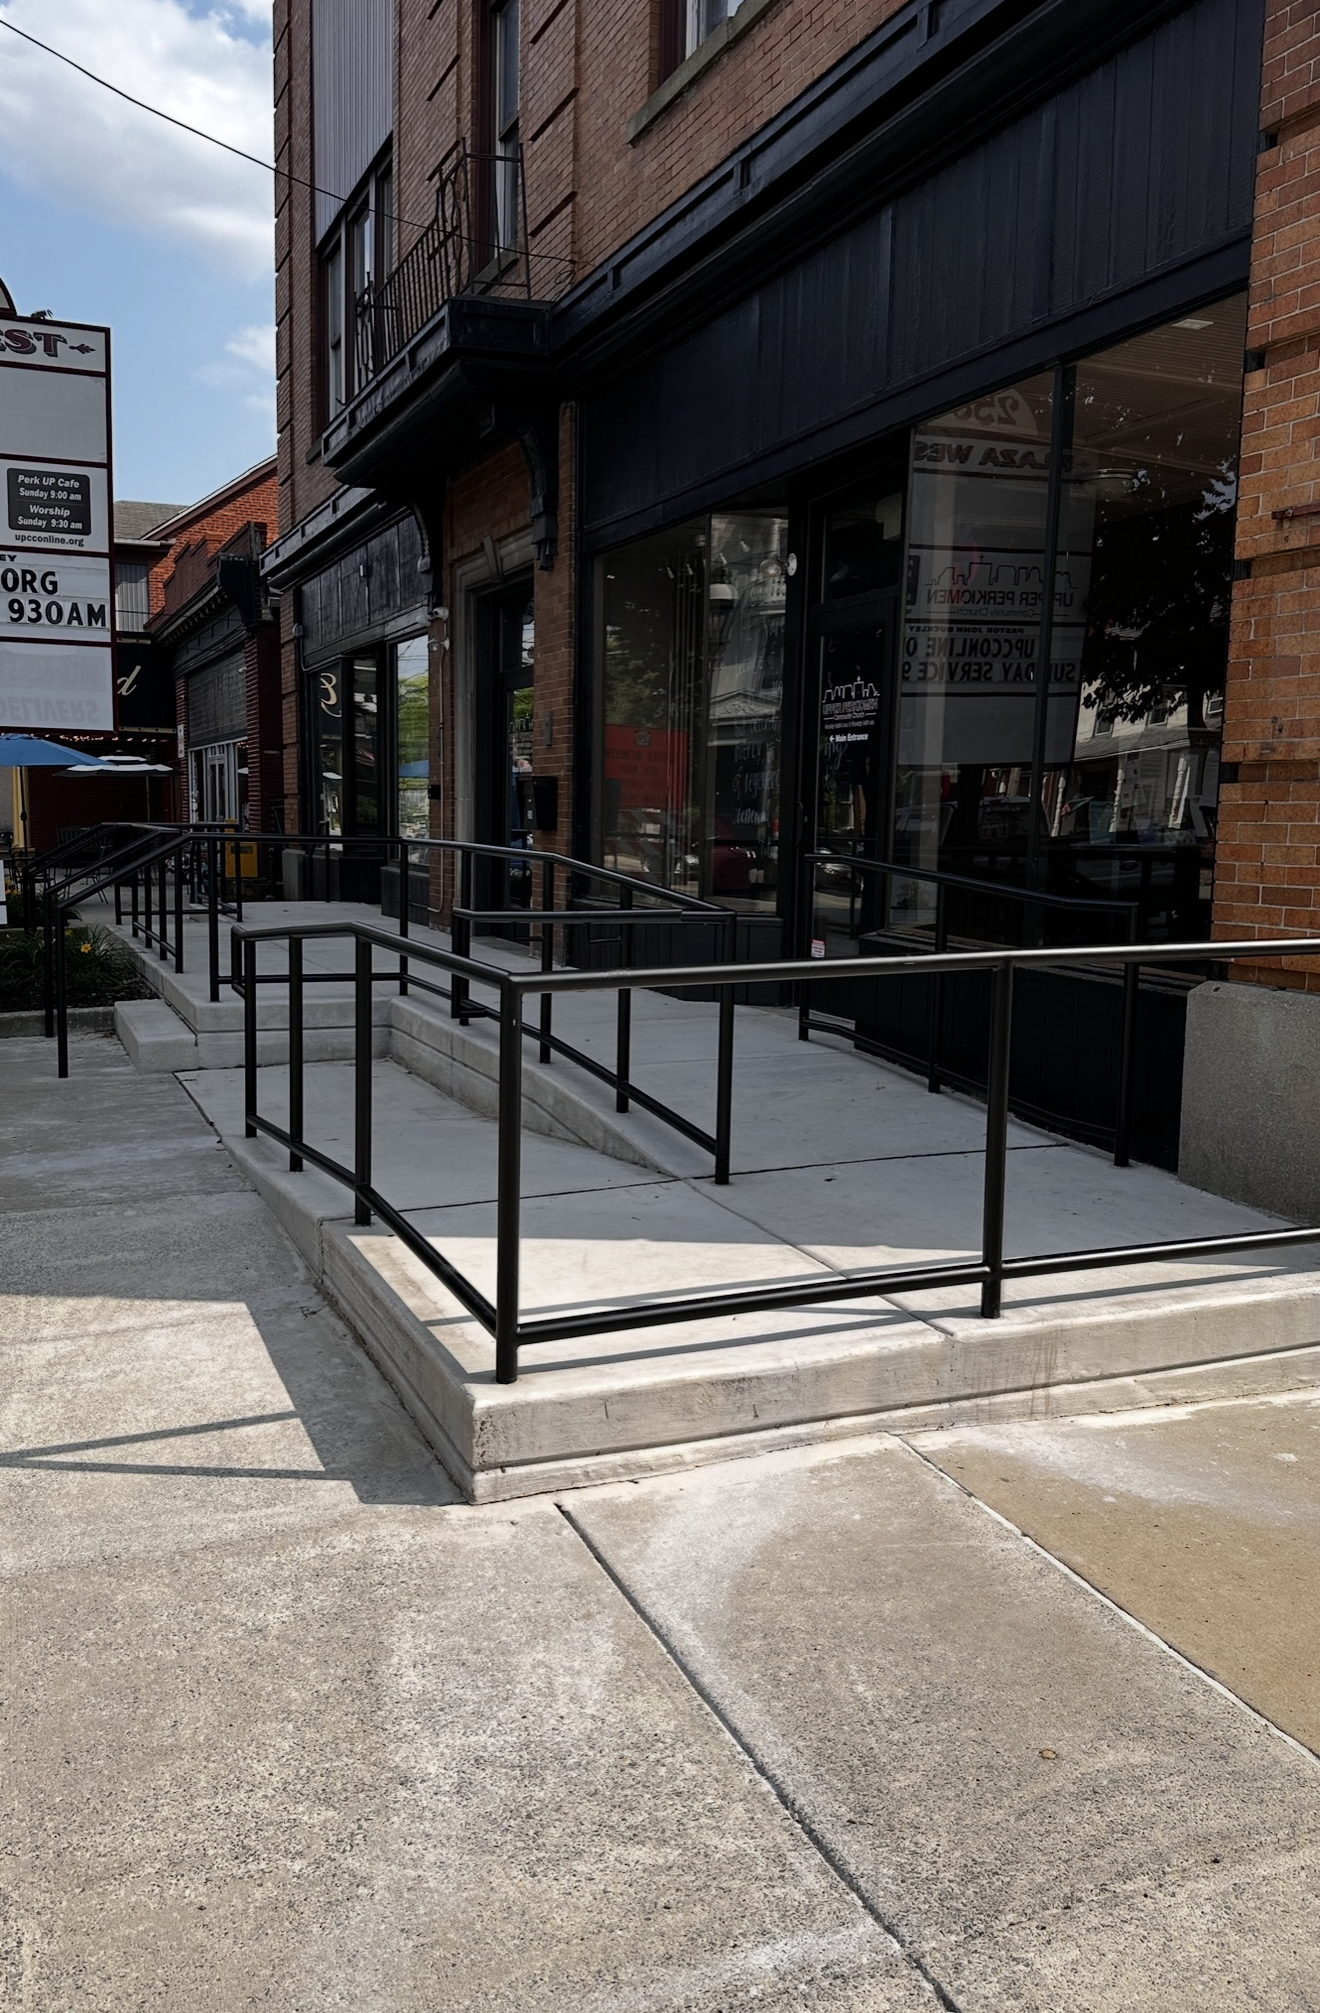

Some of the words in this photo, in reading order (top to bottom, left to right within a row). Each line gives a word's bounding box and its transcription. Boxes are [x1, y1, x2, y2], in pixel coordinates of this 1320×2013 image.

[17, 474, 41, 486] Perk
[42, 476, 56, 487] UP
[57, 478, 80, 489] Cafe
[19, 487, 49, 500] Sunday
[50, 490, 68, 500] 9:00
[69, 493, 82, 501] am
[29, 504, 71, 518] Worship
[17, 516, 47, 529] Sunday
[51, 518, 69, 529] 9:30
[70, 521, 83, 530] am
[15, 533, 85, 547] upcconline.org
[1, 567, 59, 595] ORG
[7, 598, 107, 628] 930AM
[847, 733, 869, 742] Entrance
